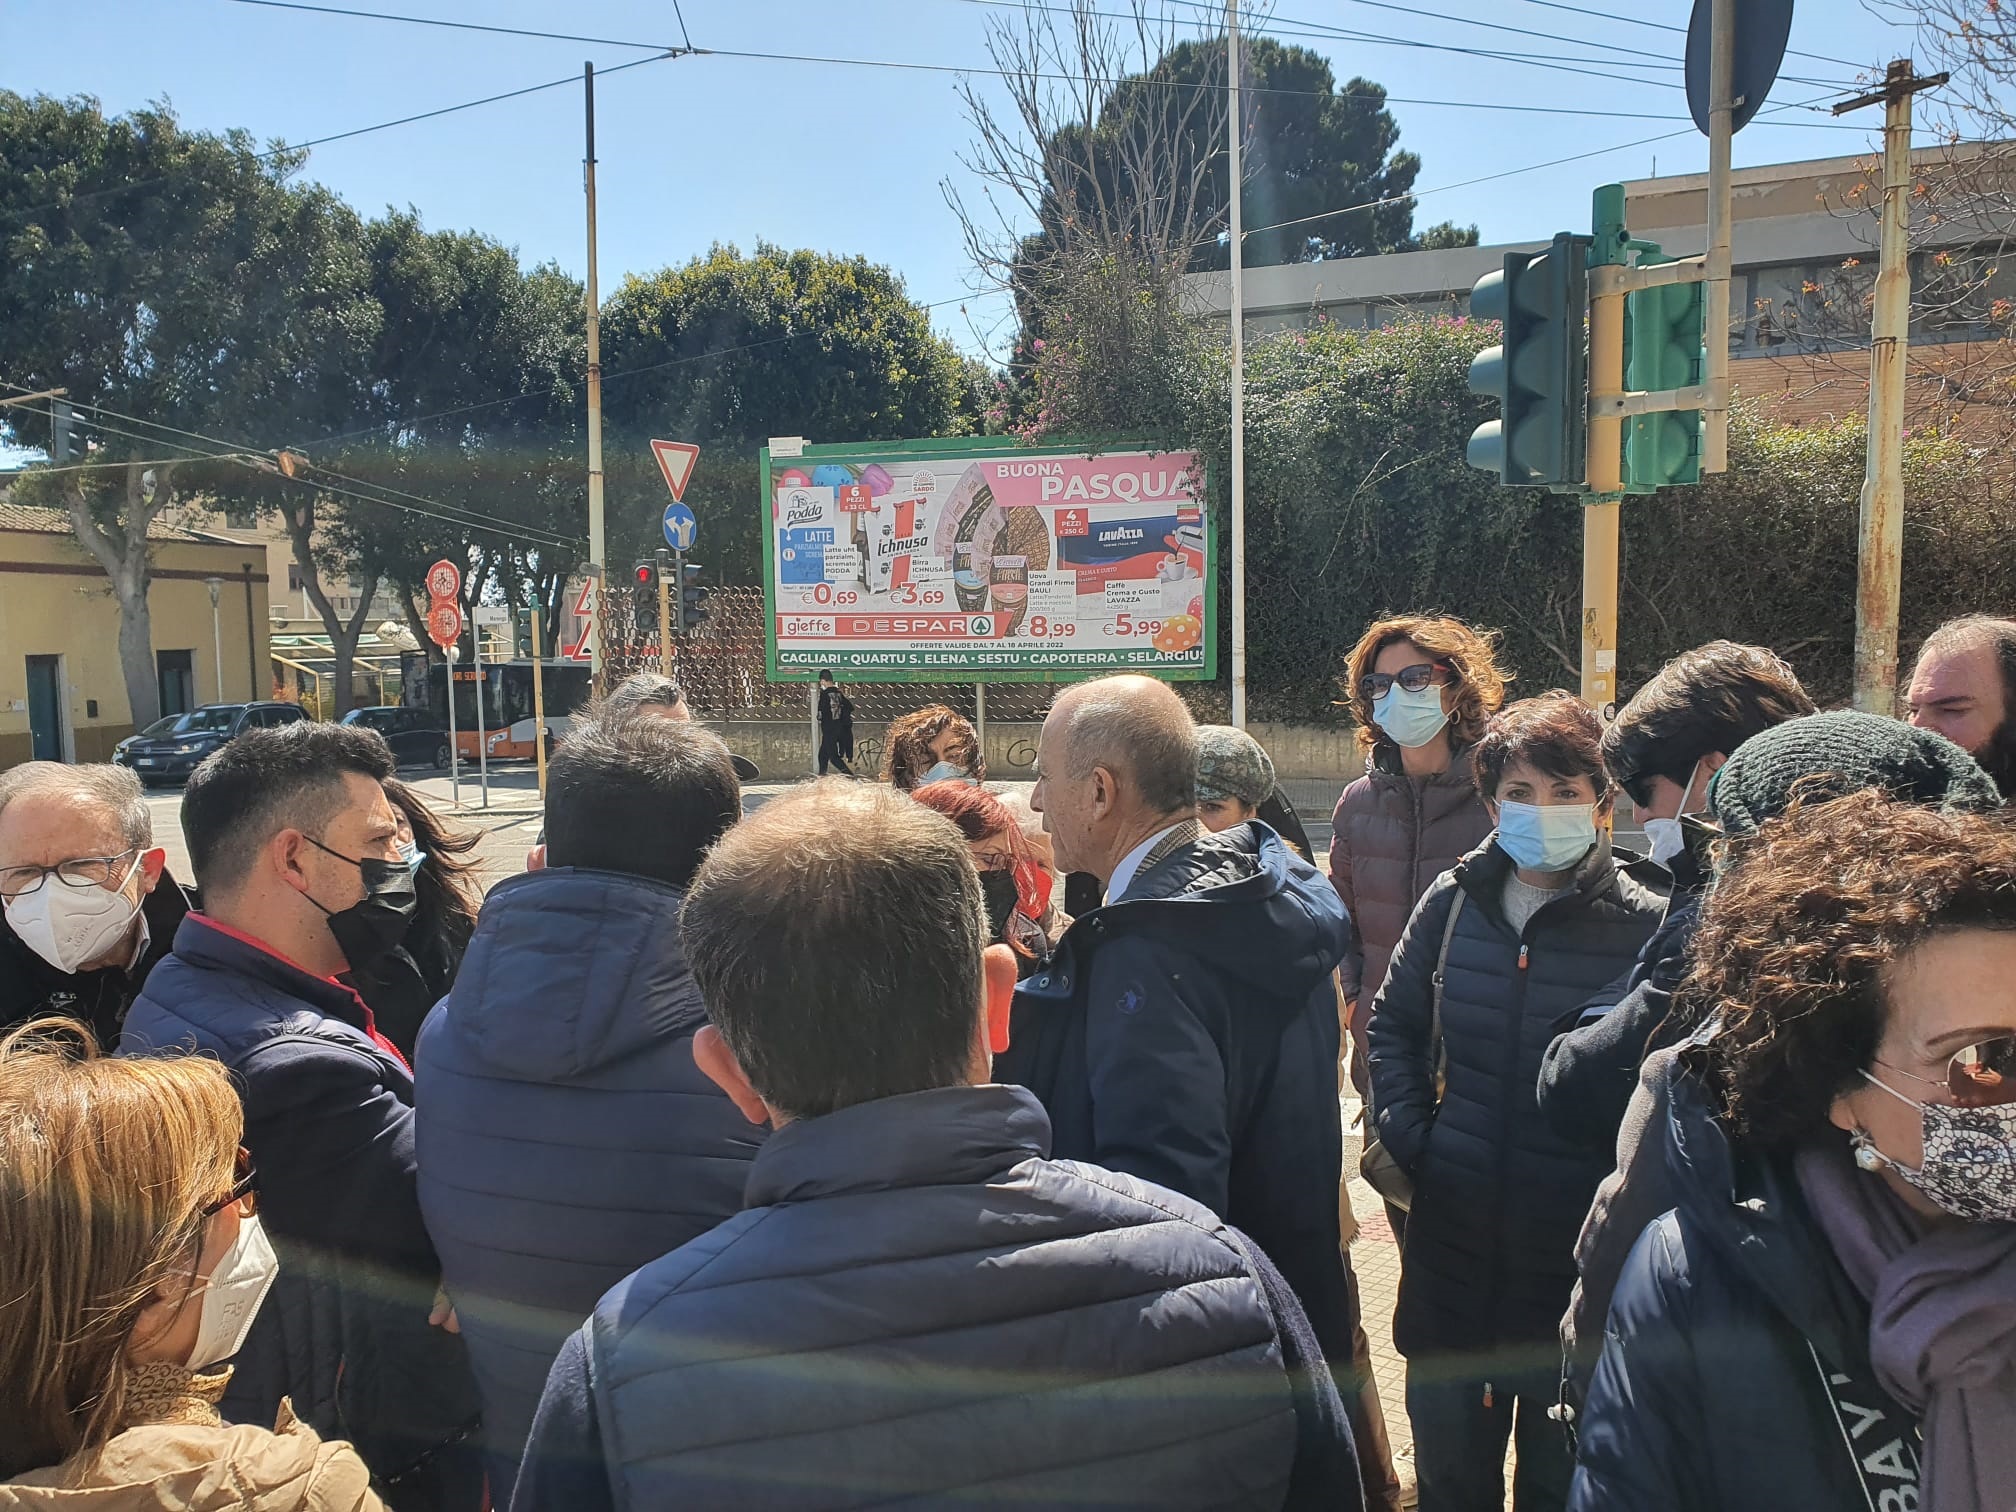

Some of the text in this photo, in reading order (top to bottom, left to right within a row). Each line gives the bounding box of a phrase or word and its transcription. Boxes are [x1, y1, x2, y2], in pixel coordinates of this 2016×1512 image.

[997, 463, 1064, 478] BUONA
[851, 487, 860, 496] 6
[1041, 471, 1195, 503] PASQUA
[787, 505, 822, 521] Podda
[1066, 510, 1076, 520] 4
[805, 530, 832, 543] LATTE
[1098, 527, 1144, 541] LAVAZZA
[801, 583, 858, 606] €0,69
[890, 583, 944, 606] €3,69
[787, 618, 831, 635] gieffe
[852, 620, 966, 633] DESPAR
[1017, 615, 1075, 639] €8,99
[1102, 613, 1161, 637] €5,99
[780, 653, 840, 663] CAGLIARI
[850, 654, 906, 665] QUARTU
[909, 654, 921, 664] S.
[924, 654, 968, 664] ELENA
[977, 654, 1019, 664] SESTU
[1030, 652, 1117, 664] CAPOTERRA
